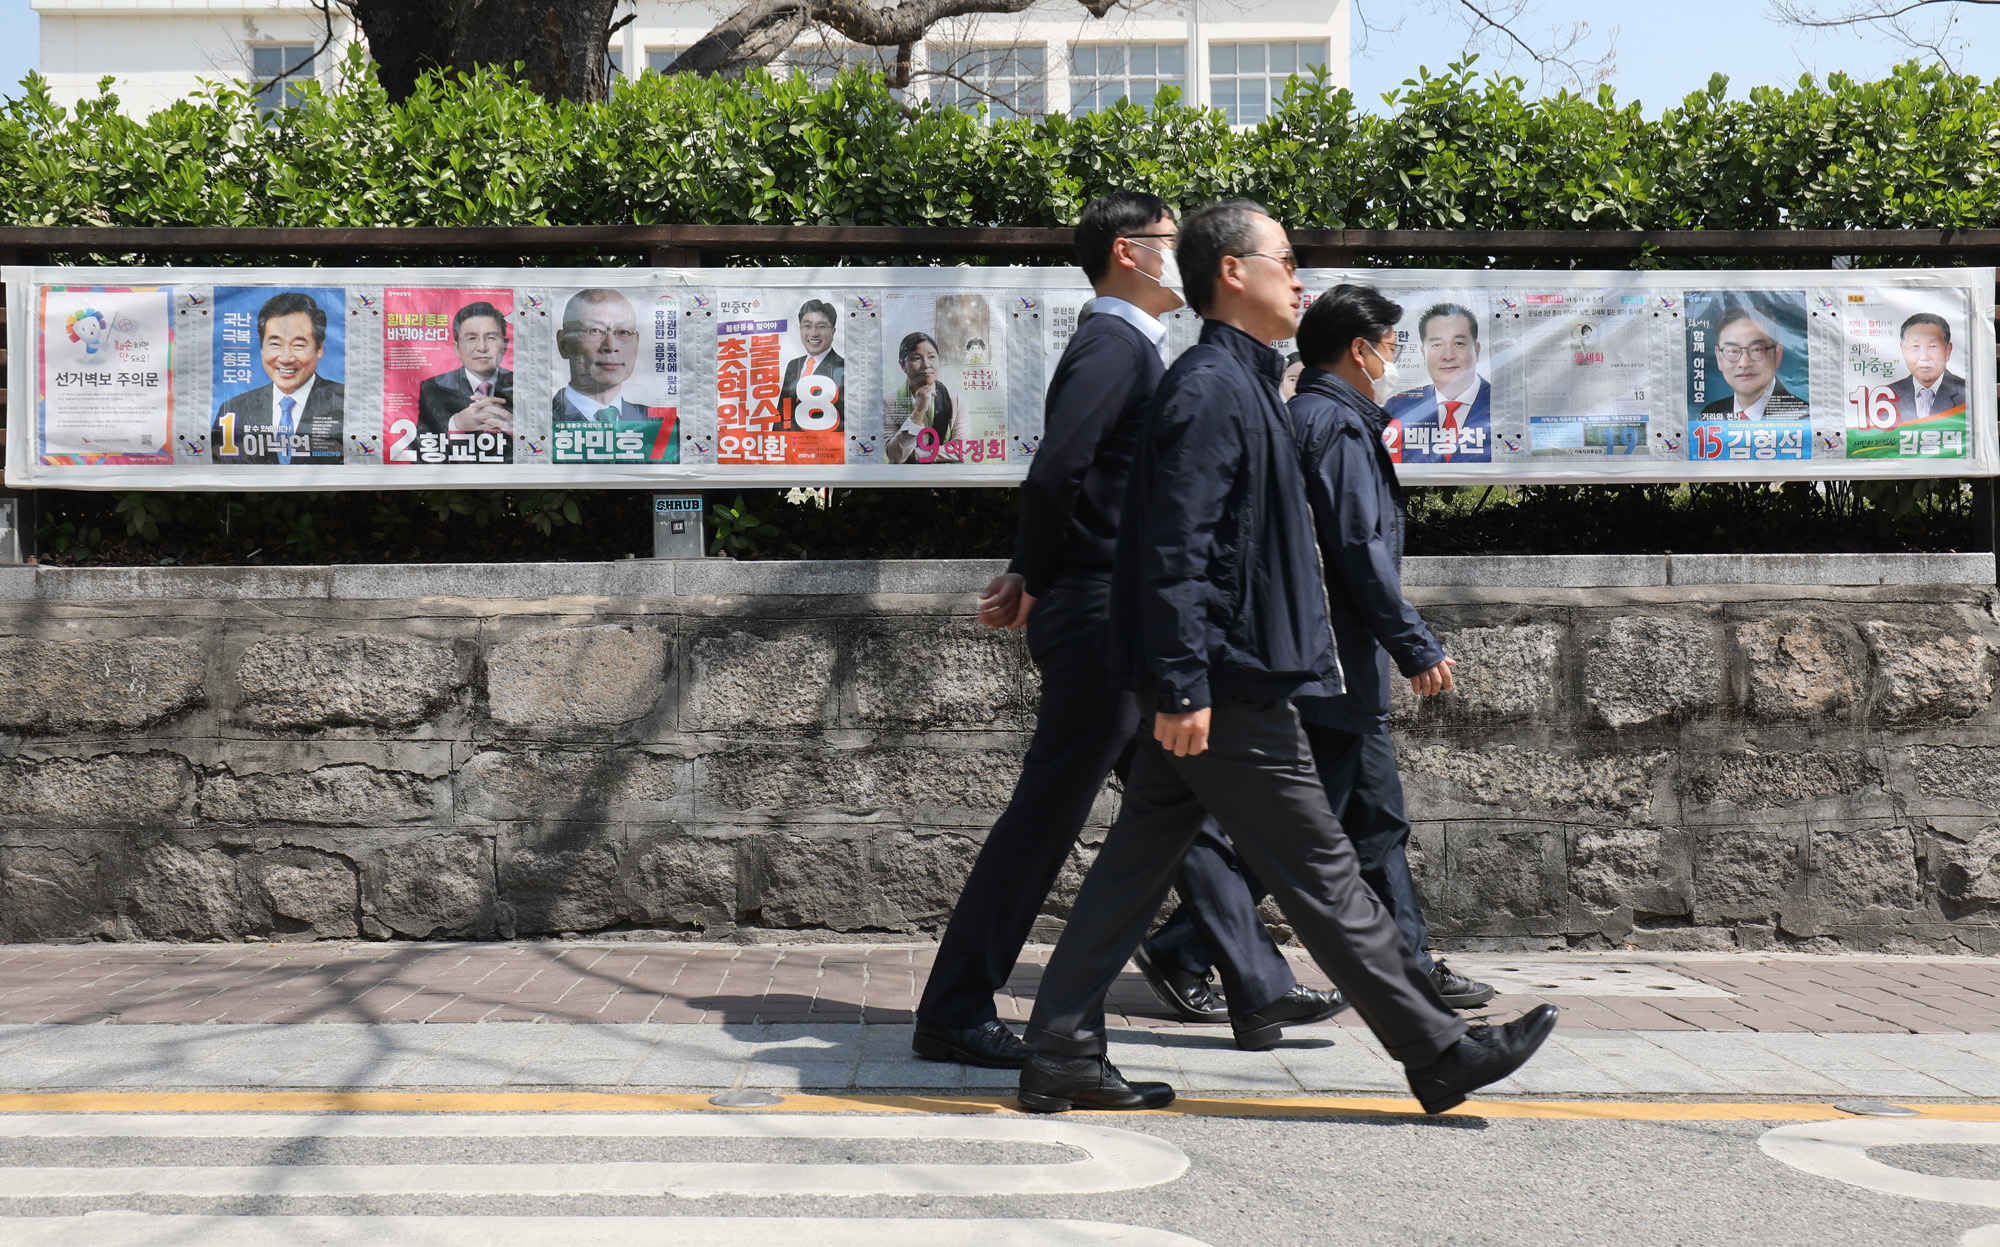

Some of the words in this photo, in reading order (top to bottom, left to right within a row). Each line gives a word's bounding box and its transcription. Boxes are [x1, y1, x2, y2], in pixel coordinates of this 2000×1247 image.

[223, 312, 252, 327] 국난
[387, 313, 423, 326] 힘내라
[425, 313, 449, 326] 종로
[720, 300, 751, 315] 민중당
[222, 329, 251, 344] 극복
[387, 328, 424, 341] 바꿔야
[425, 328, 450, 341] 산다
[654, 310, 666, 340] 유일한
[666, 310, 677, 340] 정권의
[1394, 331, 1409, 342] 한
[114, 339, 149, 350] 훼손하면
[717, 334, 781, 373] 촛불
[1692, 330, 1705, 353] 함께
[1850, 342, 1877, 357] 희망의
[119, 352, 129, 362] 안
[222, 352, 252, 367] 종로
[654, 342, 666, 373] 공무원
[1574, 352, 1605, 365] 양세화
[55, 372, 112, 387] 선거벽보
[117, 372, 159, 387] 주의문
[222, 369, 252, 384] 도약
[667, 375, 678, 395] 맞선
[717, 366, 780, 402] 혁명
[1693, 357, 1705, 403] 이겨내요
[795, 374, 840, 432] 8
[1634, 390, 1645, 401] 13
[717, 397, 792, 432] 완수!
[1702, 412, 1724, 421] 거리의
[1726, 412, 1742, 421] 천사
[1848, 385, 1900, 433] 16
[219, 412, 240, 456] 1
[243, 434, 311, 457] 이낙연
[389, 418, 418, 462] 2
[554, 429, 645, 460] 한민호
[648, 407, 677, 460] 7
[916, 427, 941, 463] 9
[1404, 427, 1486, 455] 백병찬
[1603, 426, 1639, 456] 19
[1693, 425, 1724, 460] 15
[1726, 429, 1804, 460] 김형석
[1898, 430, 1963, 455] 김용덕
[420, 432, 507, 463] 황교안
[718, 434, 788, 462] 오인환
[945, 438, 1006, 463] 이정희
[656, 500, 700, 511] SHRUB
